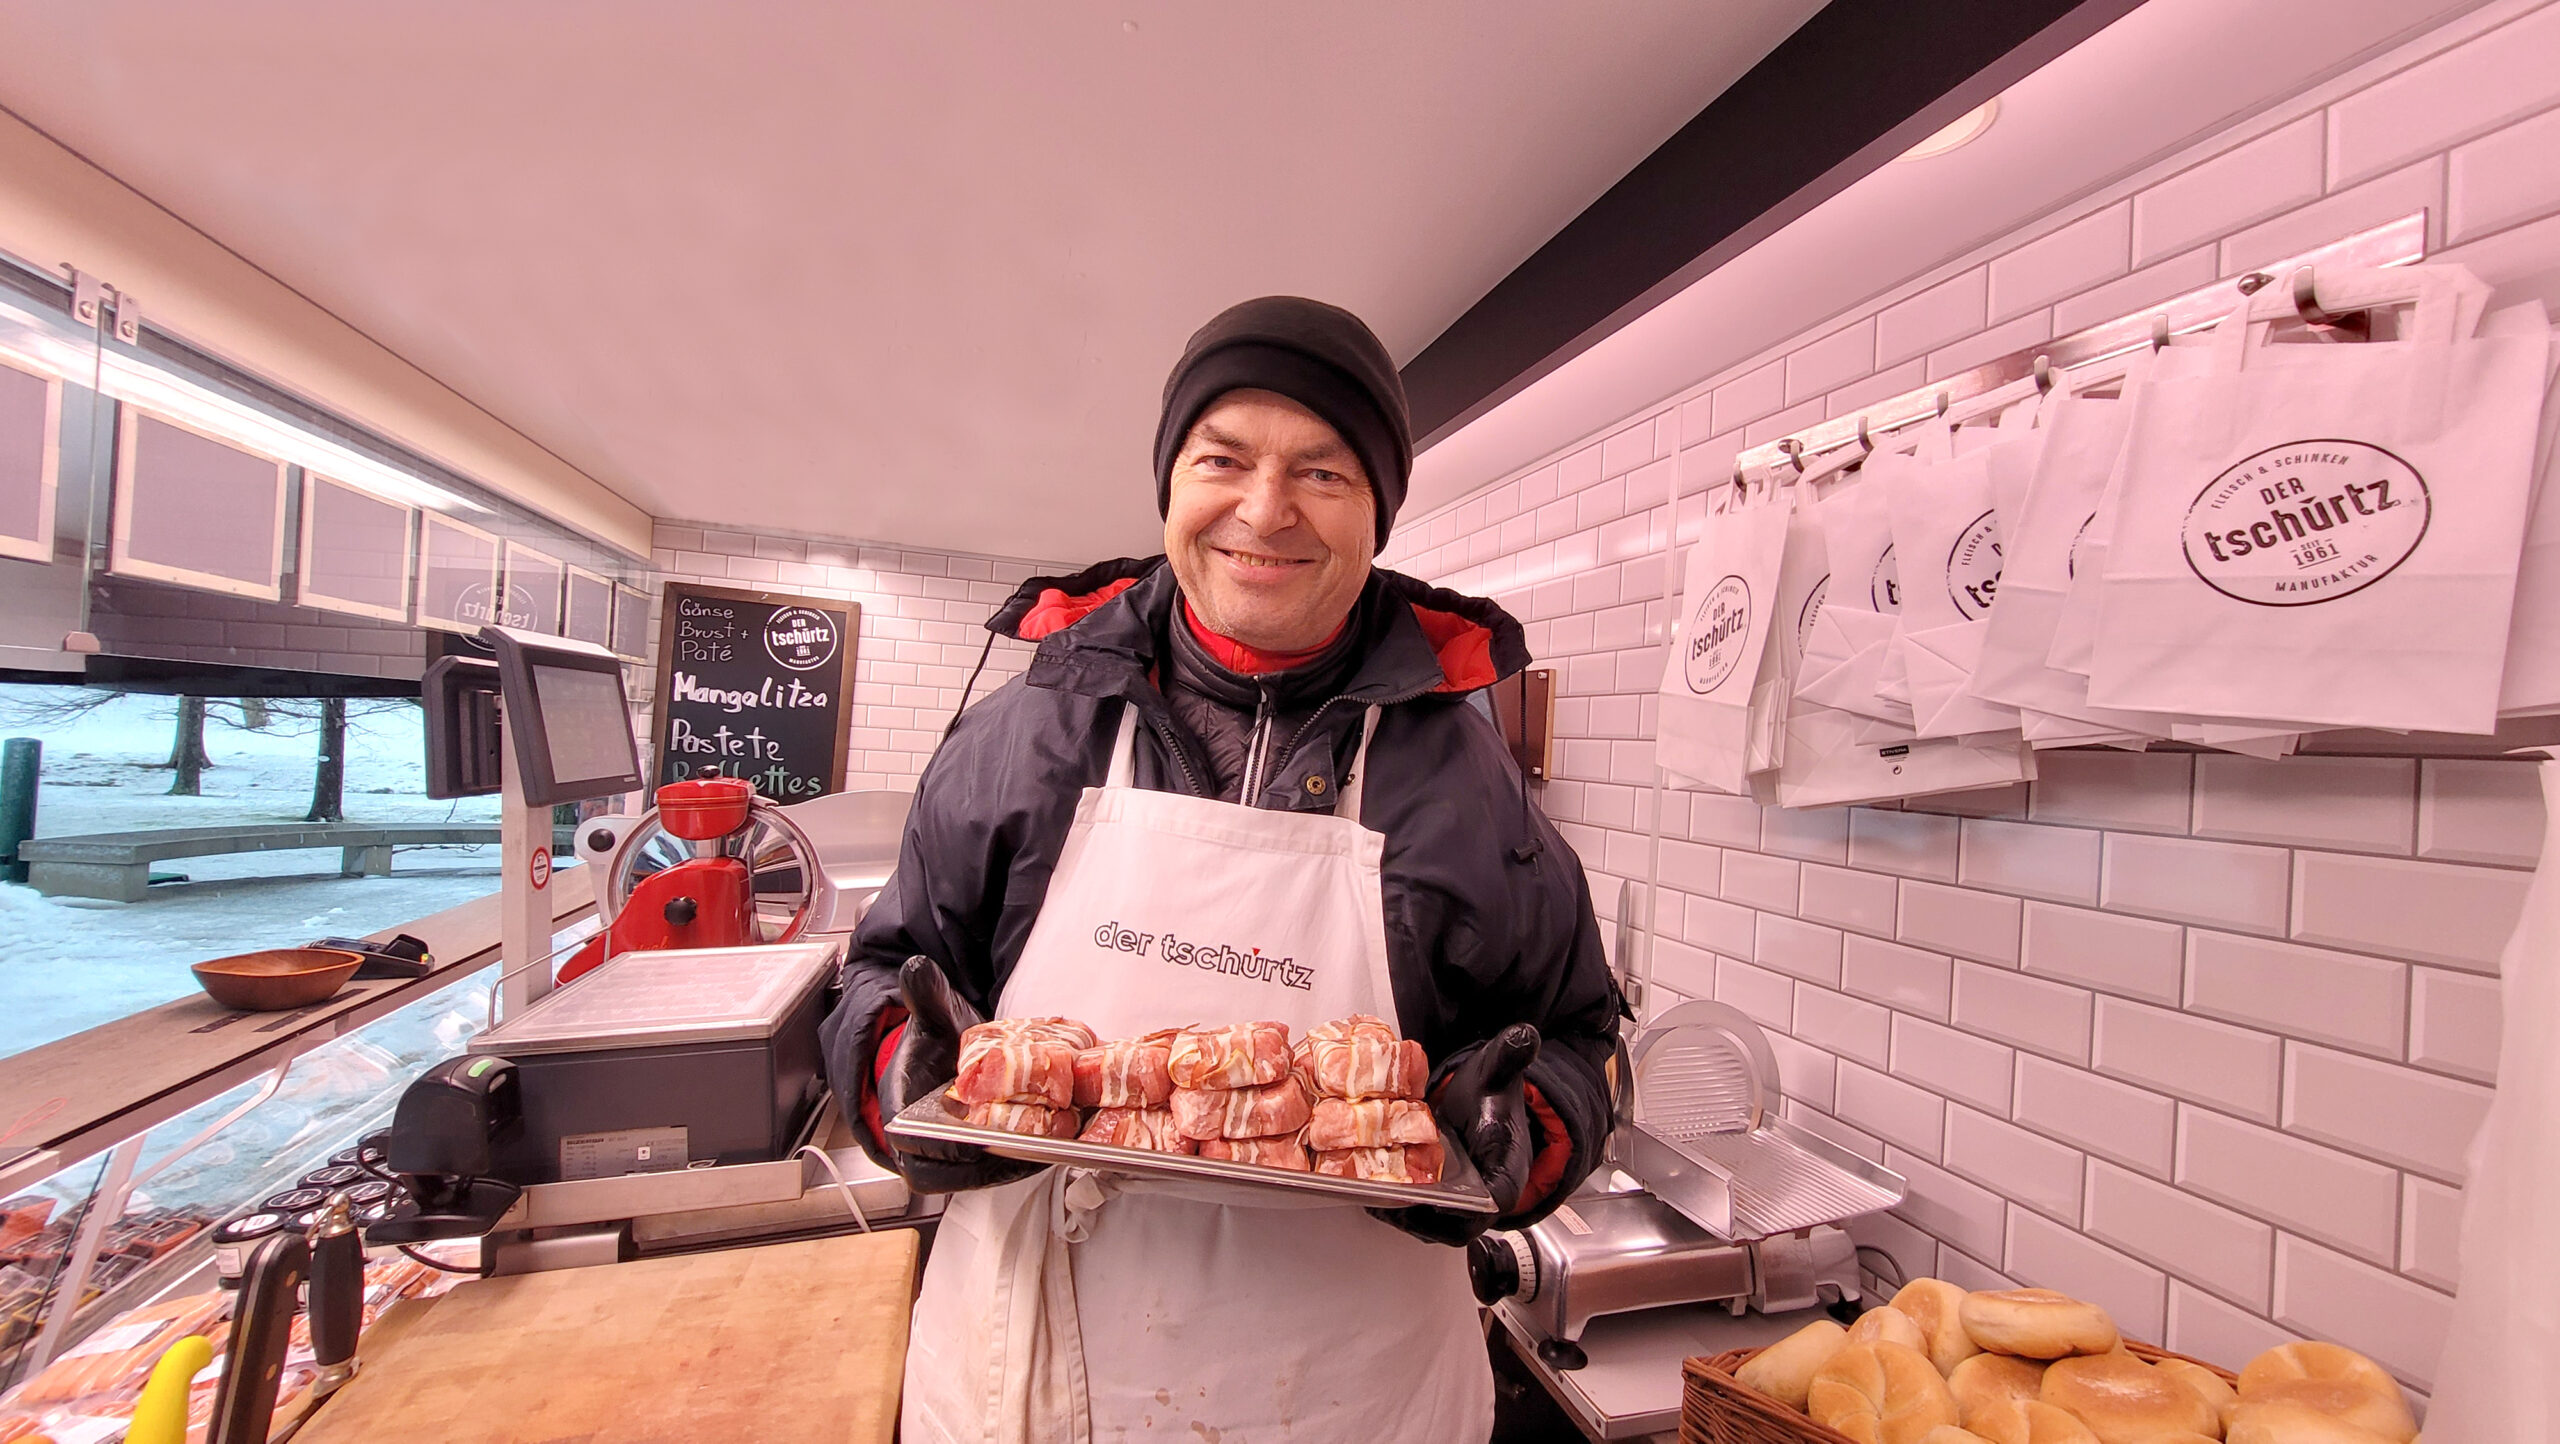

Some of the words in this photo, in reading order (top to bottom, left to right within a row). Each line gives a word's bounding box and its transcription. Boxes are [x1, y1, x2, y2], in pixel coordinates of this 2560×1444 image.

[2211, 473, 2254, 510] FLEISCH
[2258, 465, 2269, 475] &
[2274, 452, 2350, 468] SCHINKEN
[2259, 476, 2306, 506] DER
[2274, 553, 2379, 592] MANUFAKTUR
[2293, 542, 2341, 567] 1961
[679, 622, 735, 639] Brust
[680, 640, 734, 662] Paté
[673, 671, 828, 713] Mangalitza
[670, 718, 785, 762] Pastete
[672, 759, 822, 796] Rllettes
[1094, 921, 1155, 957] der
